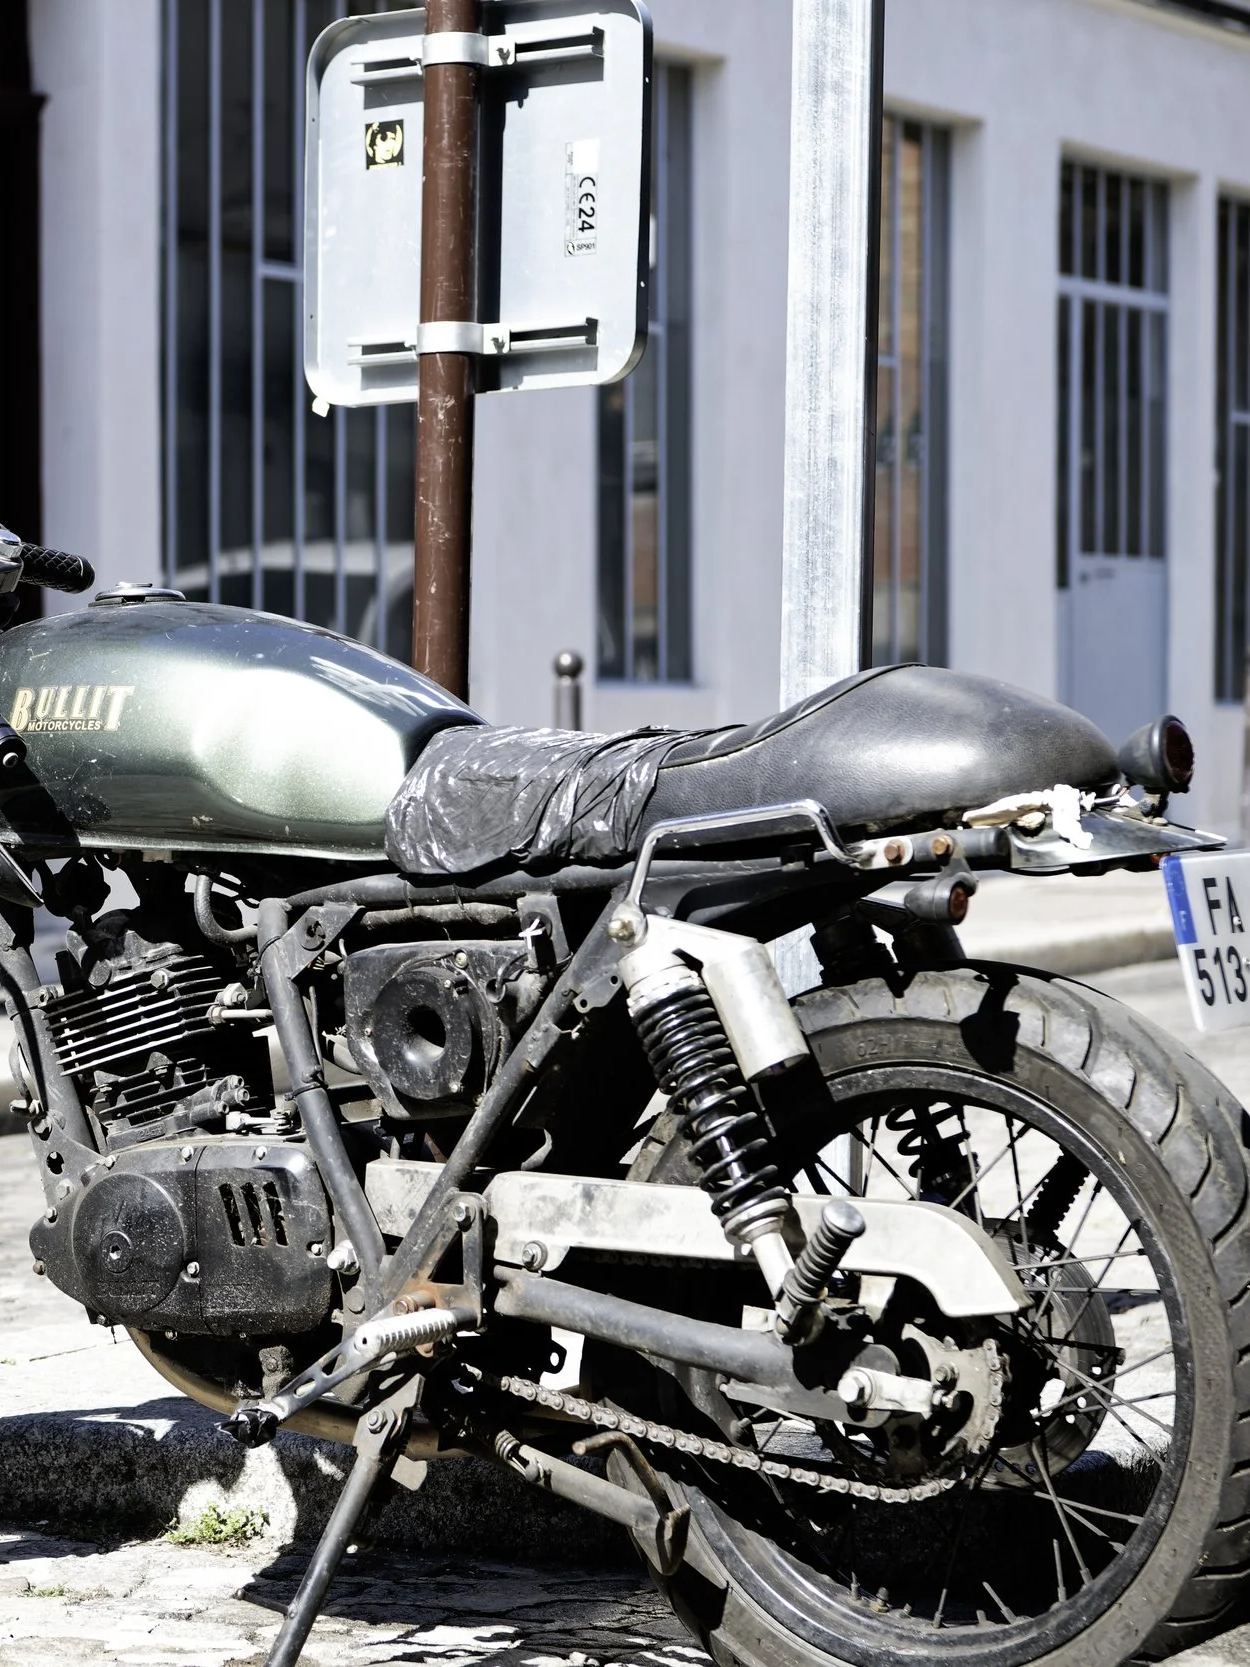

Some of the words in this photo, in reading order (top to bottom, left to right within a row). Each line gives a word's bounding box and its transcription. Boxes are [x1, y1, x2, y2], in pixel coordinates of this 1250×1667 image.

[10, 685, 135, 732] BULLIT
[27, 720, 101, 731] MOTORCYCLES
[1203, 876, 1246, 936] FA
[1193, 946, 1248, 1007] 513
